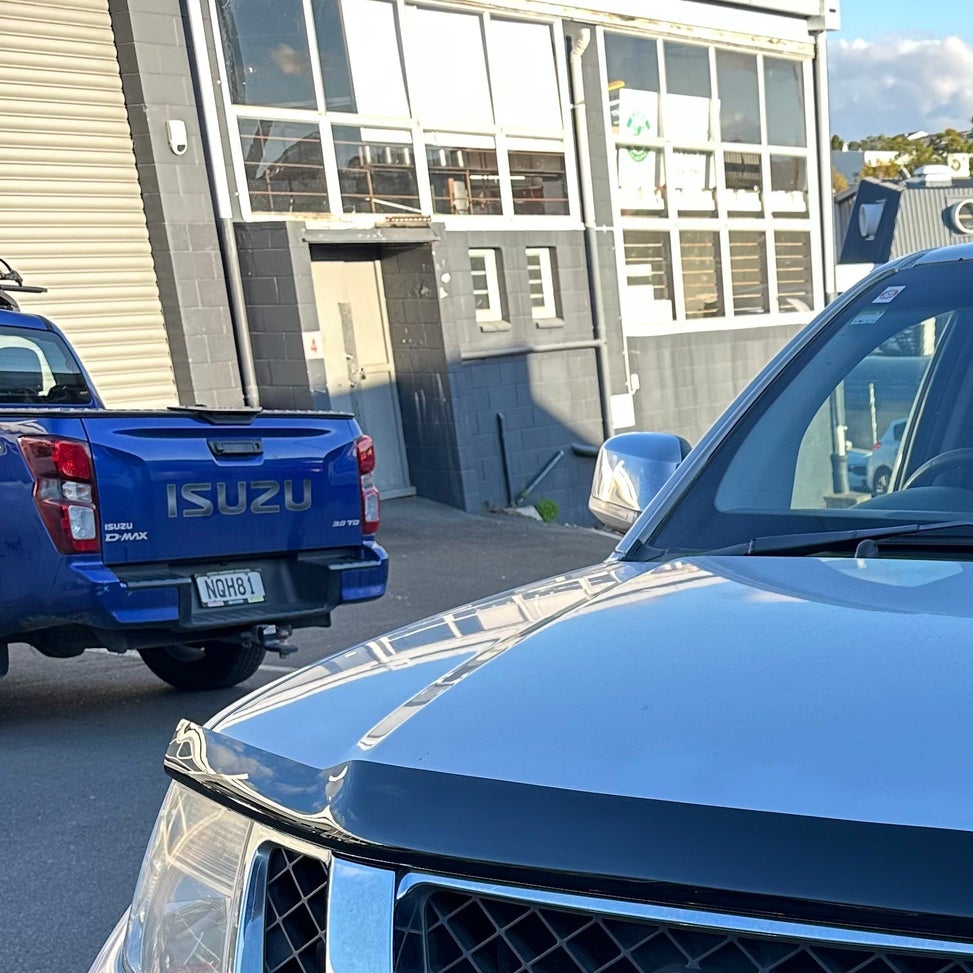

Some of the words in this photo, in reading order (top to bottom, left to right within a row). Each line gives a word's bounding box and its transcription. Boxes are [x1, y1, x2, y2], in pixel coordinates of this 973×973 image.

[166, 479, 312, 518] ISUZU
[104, 522, 133, 531] ISUZU
[105, 531, 148, 542] D-MAX
[204, 575, 255, 599] NQH81
